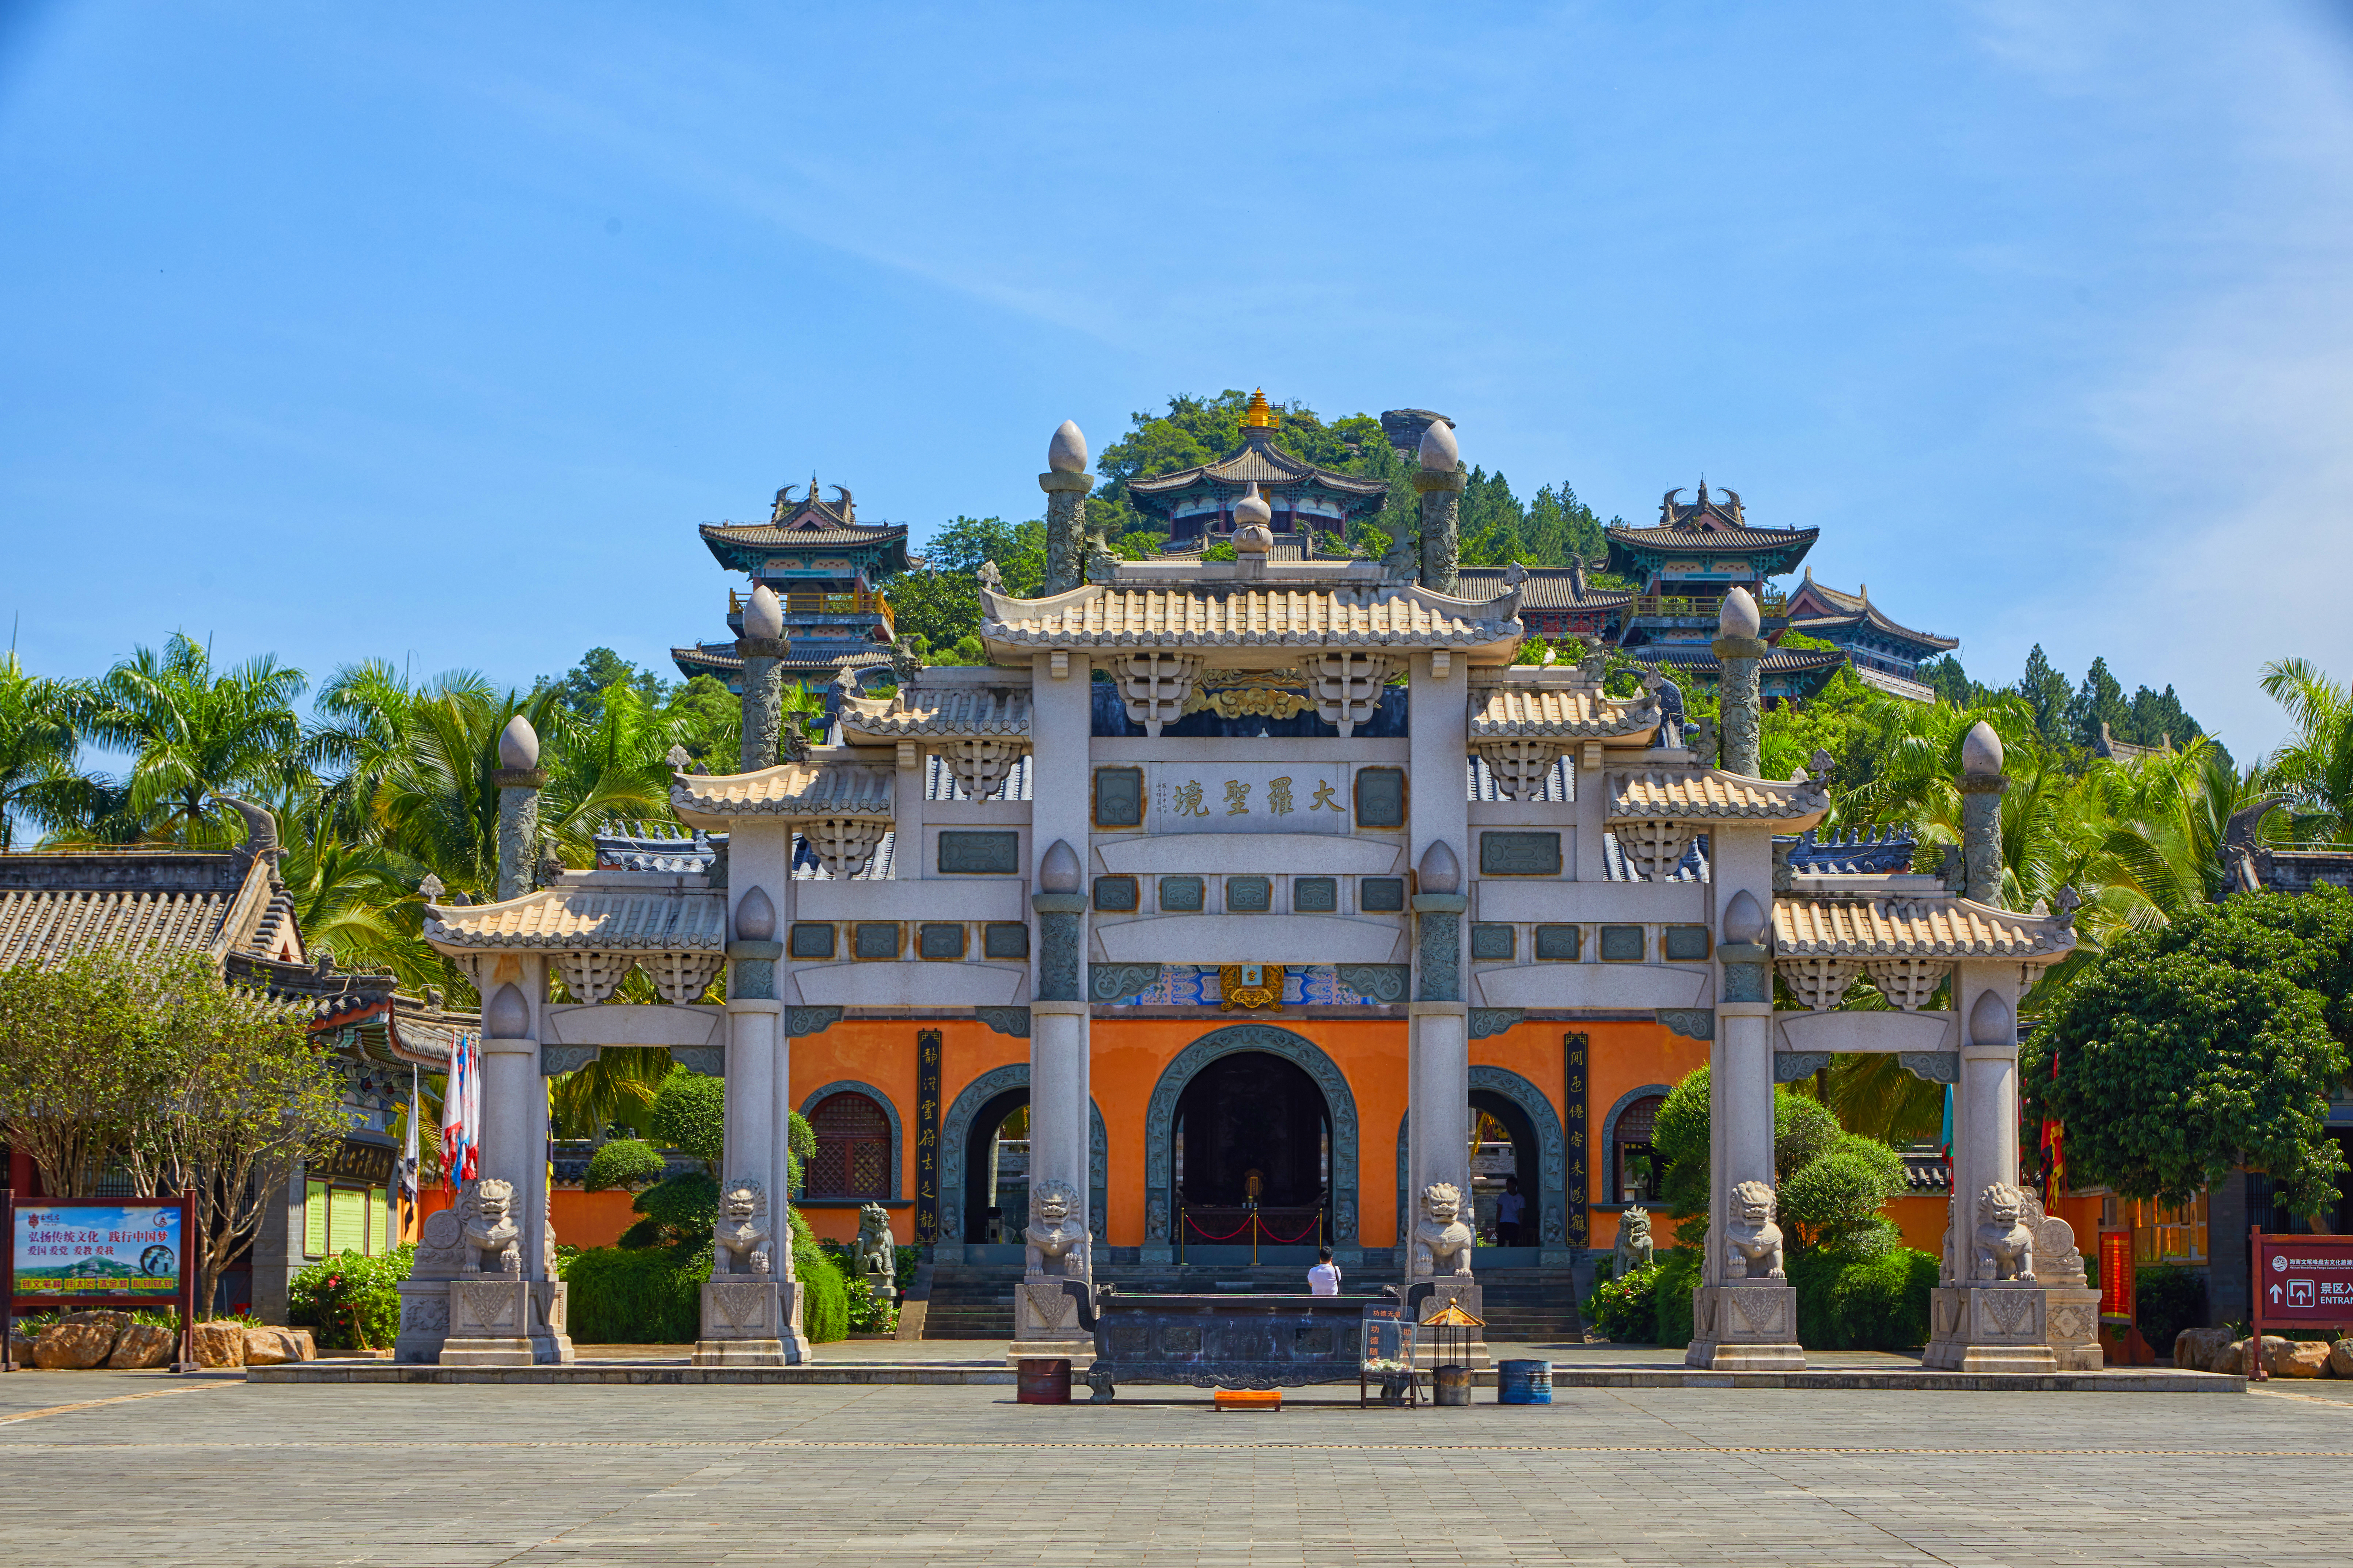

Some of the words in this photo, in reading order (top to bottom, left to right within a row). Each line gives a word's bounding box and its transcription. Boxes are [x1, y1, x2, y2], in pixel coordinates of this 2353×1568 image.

[29, 1231, 99, 1242] 弘扬传统文化
[109, 1230, 168, 1242] 践行中国梦
[27, 1246, 46, 1255] 爱国
[49, 1246, 68, 1255] 爱党
[73, 1246, 92, 1255] 爱教
[95, 1245, 114, 1255] 爱我
[2320, 1283, 2353, 1294] 景区入
